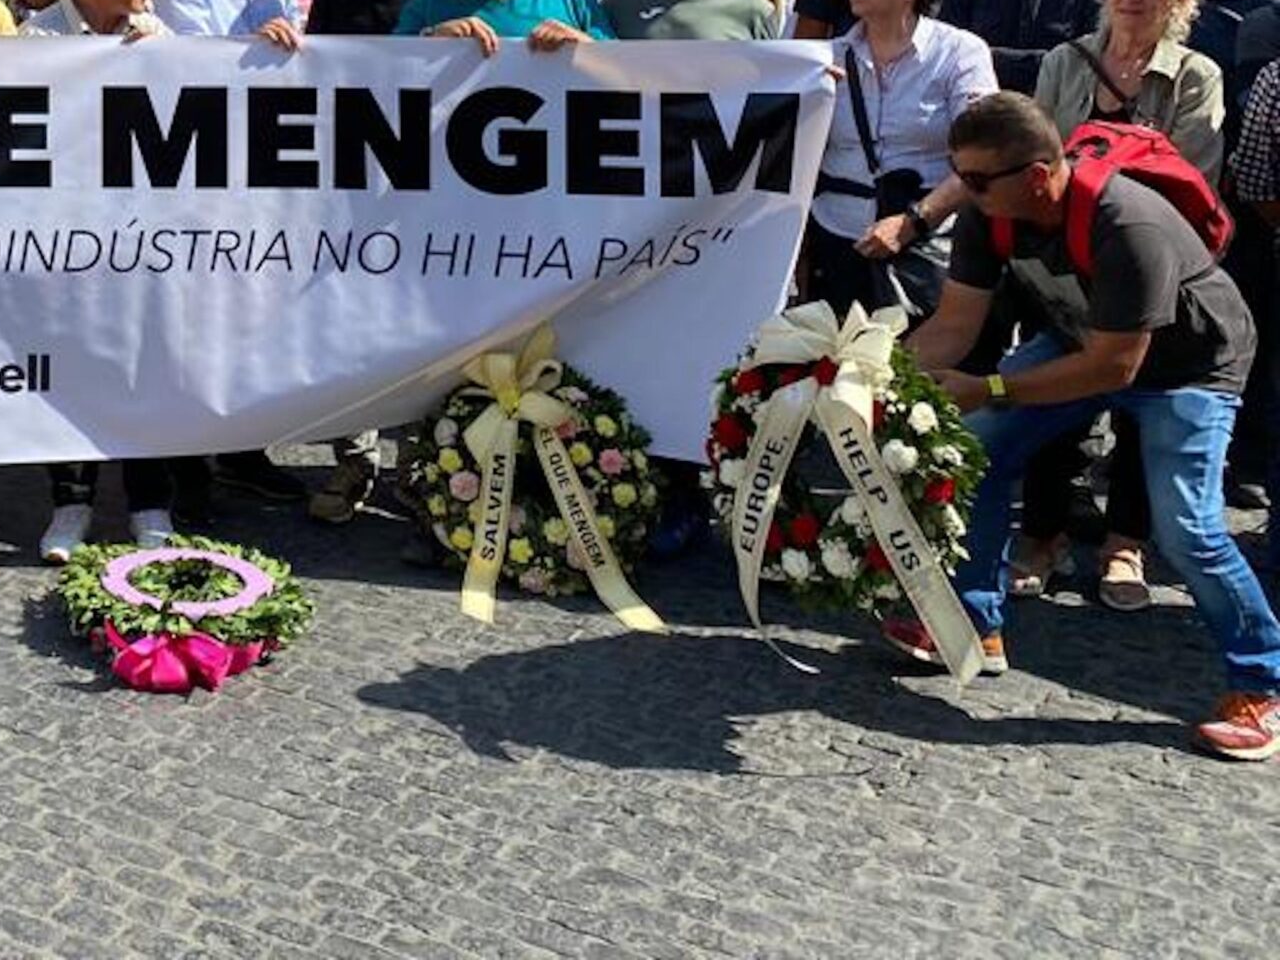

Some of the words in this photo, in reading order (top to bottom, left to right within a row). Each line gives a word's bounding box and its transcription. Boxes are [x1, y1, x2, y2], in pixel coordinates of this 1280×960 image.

[101, 85, 801, 199] MENGEM
[312, 228, 402, 276] NO
[421, 232, 476, 279] HI
[494, 235, 574, 281] HA
[480, 454, 507, 561] SALVEM
[539, 429, 554, 450] EL
[549, 453, 571, 490] QUE
[565, 492, 607, 569] MENGEM
[839, 428, 889, 505] HELP
[889, 530, 920, 572] US
